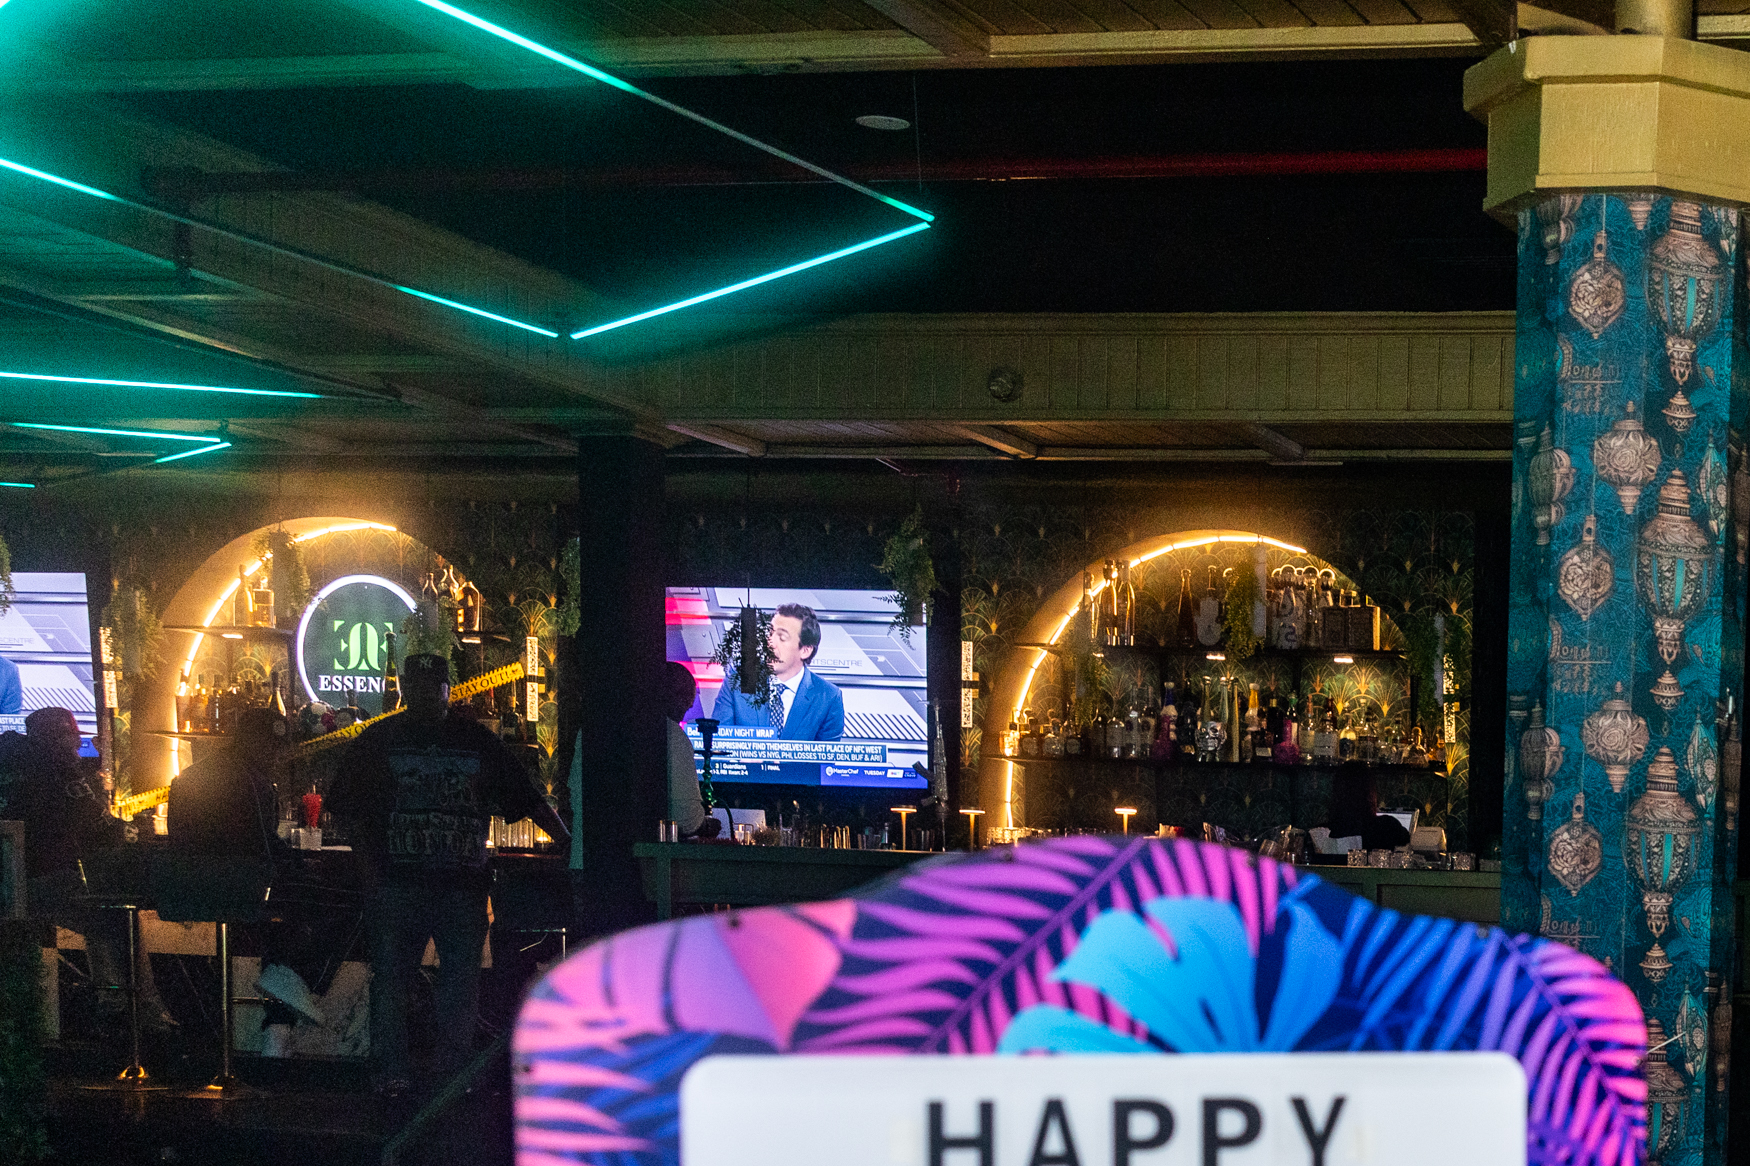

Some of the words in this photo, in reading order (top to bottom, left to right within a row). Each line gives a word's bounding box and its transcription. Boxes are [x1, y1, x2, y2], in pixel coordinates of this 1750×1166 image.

[451, 681, 478, 699] STAY
[734, 728, 754, 738] NIGHT
[755, 728, 775, 738] WRAP
[711, 741, 752, 751] SURPRISINGLY
[752, 742, 766, 751] FIND
[766, 743, 803, 752] THEMSELVES
[803, 743, 810, 752] IN
[810, 744, 826, 753] LAST
[826, 744, 845, 753] PLACE
[844, 745, 853, 753] OF
[865, 745, 883, 754] WEST
[758, 751, 767, 759] VS
[794, 752, 818, 760] LOSSES
[817, 752, 827, 760] TO
[851, 753, 864, 761] BUF
